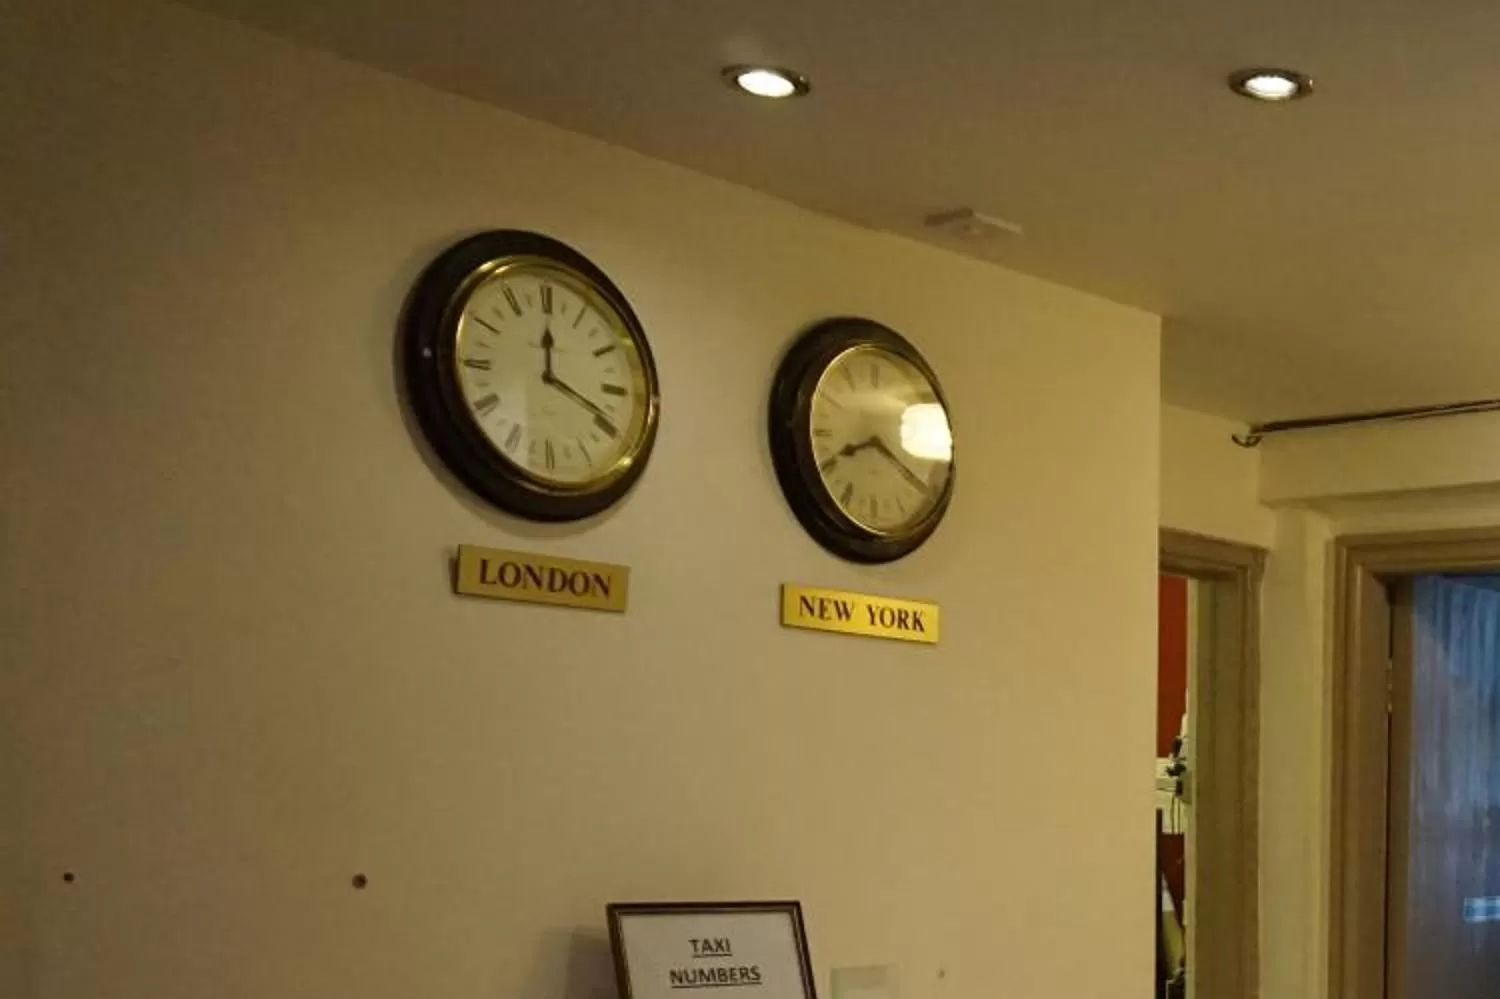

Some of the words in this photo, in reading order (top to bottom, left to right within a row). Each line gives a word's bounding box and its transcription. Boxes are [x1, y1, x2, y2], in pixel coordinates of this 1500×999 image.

[478, 558, 612, 600] LONDON
[799, 595, 855, 622] NEW
[866, 603, 927, 633] YORK
[688, 937, 732, 955] TAXI
[669, 965, 762, 985] NUMBERS
